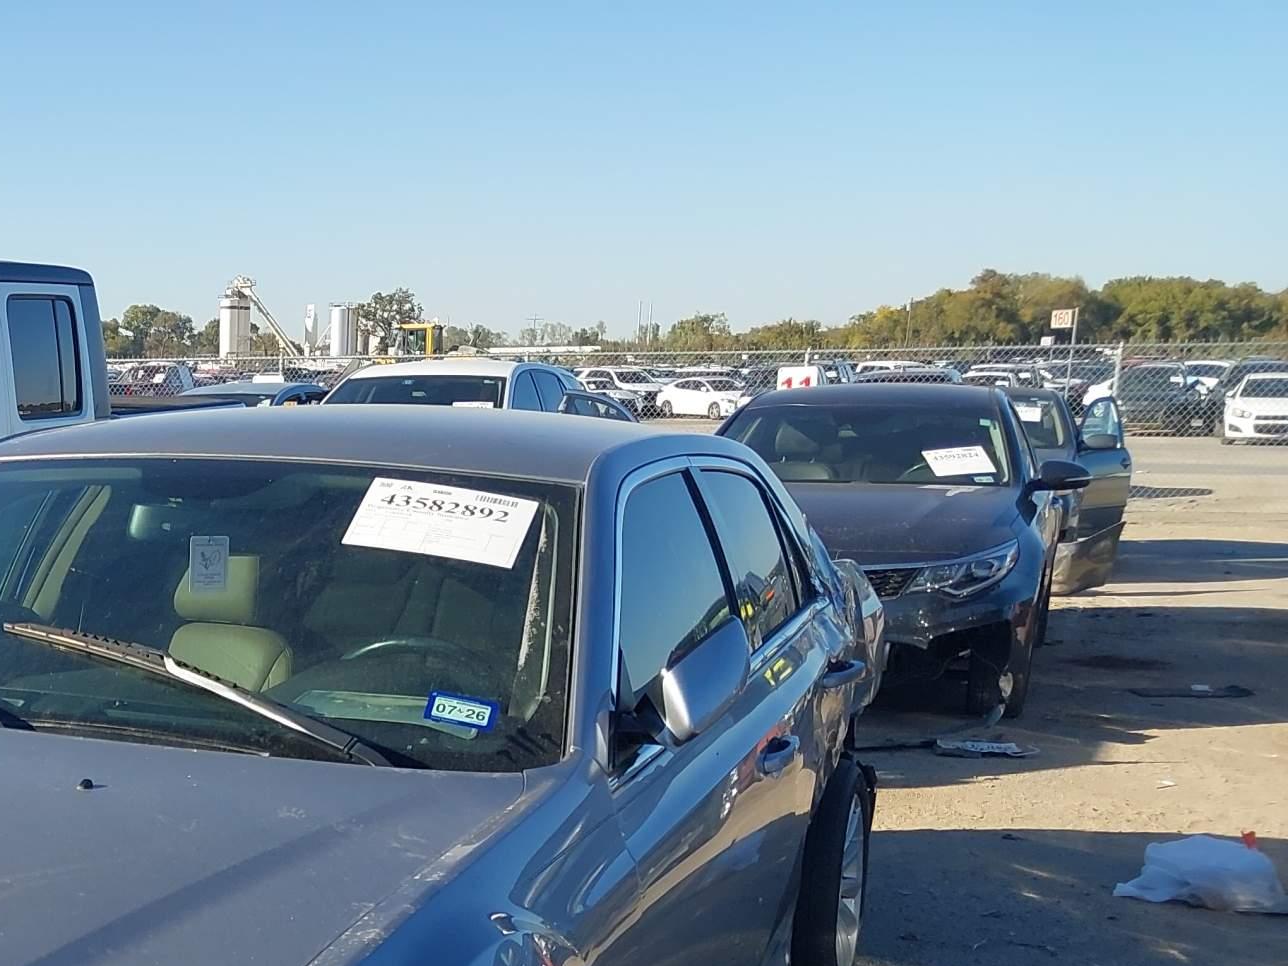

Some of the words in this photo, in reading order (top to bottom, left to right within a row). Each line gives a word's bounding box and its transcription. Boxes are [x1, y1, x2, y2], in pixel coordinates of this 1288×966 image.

[1053, 311, 1070, 326] 160
[380, 493, 510, 523] 43582892
[435, 703, 457, 715] 07
[464, 708, 486, 721] 26
